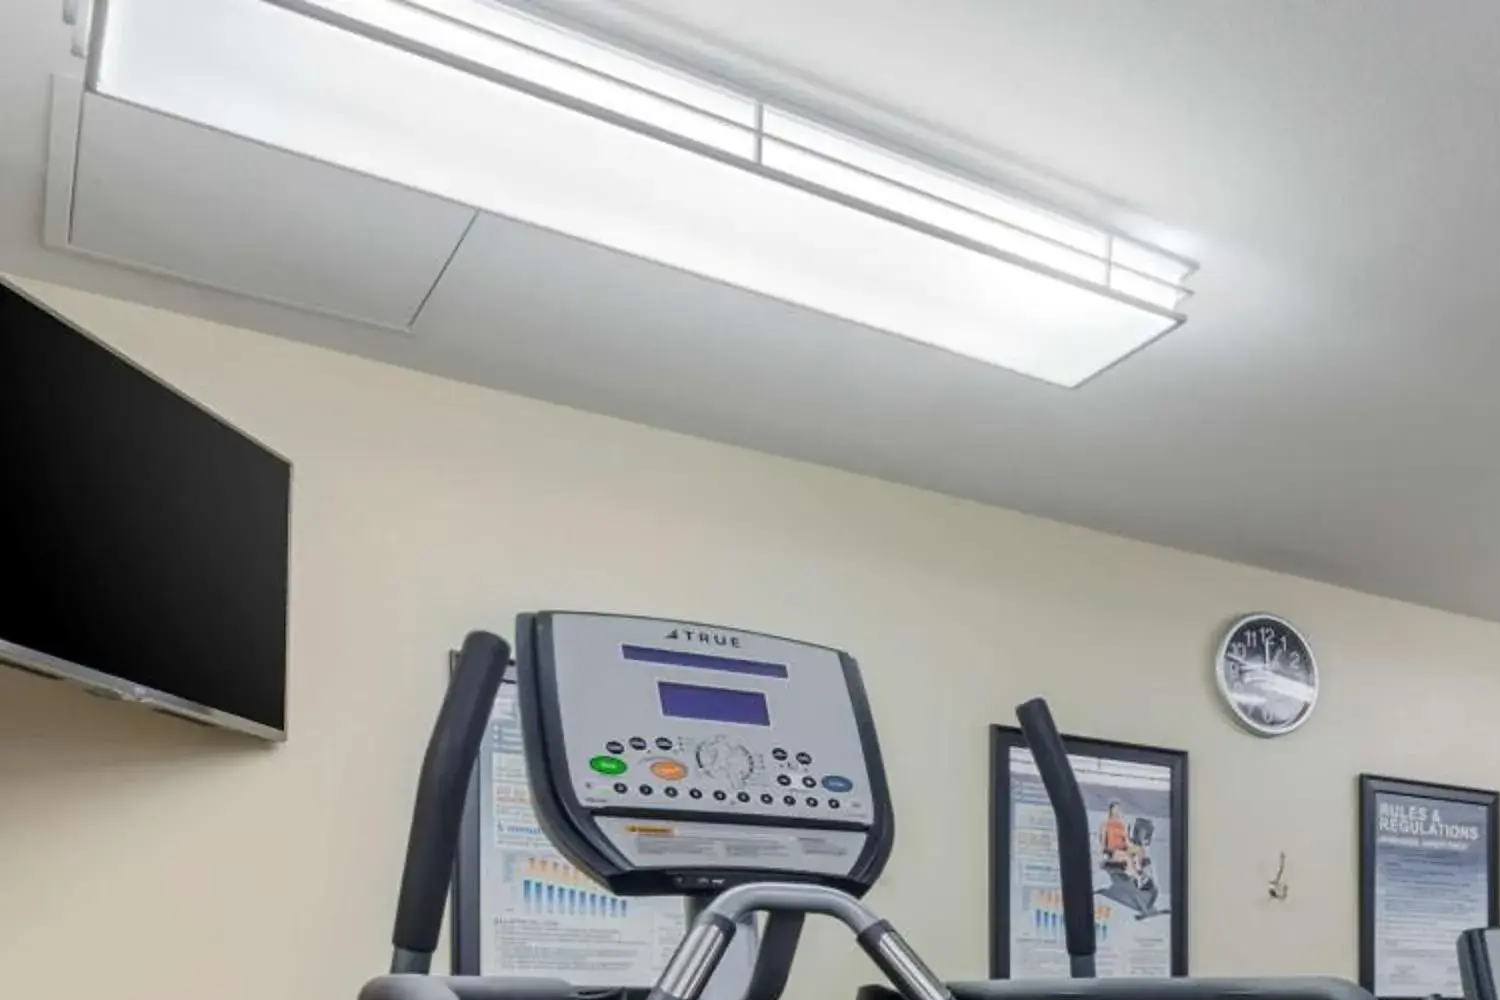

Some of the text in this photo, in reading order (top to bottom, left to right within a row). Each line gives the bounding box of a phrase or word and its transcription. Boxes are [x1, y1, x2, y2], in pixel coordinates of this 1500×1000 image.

[684, 630, 741, 649] TRUE
[1244, 630, 1257, 648] 11
[1260, 627, 1275, 642] 12
[1280, 636, 1287, 651] 1
[1290, 651, 1301, 670] 2
[1379, 802, 1428, 821] RULES
[1378, 817, 1479, 840] REGULATIONS
